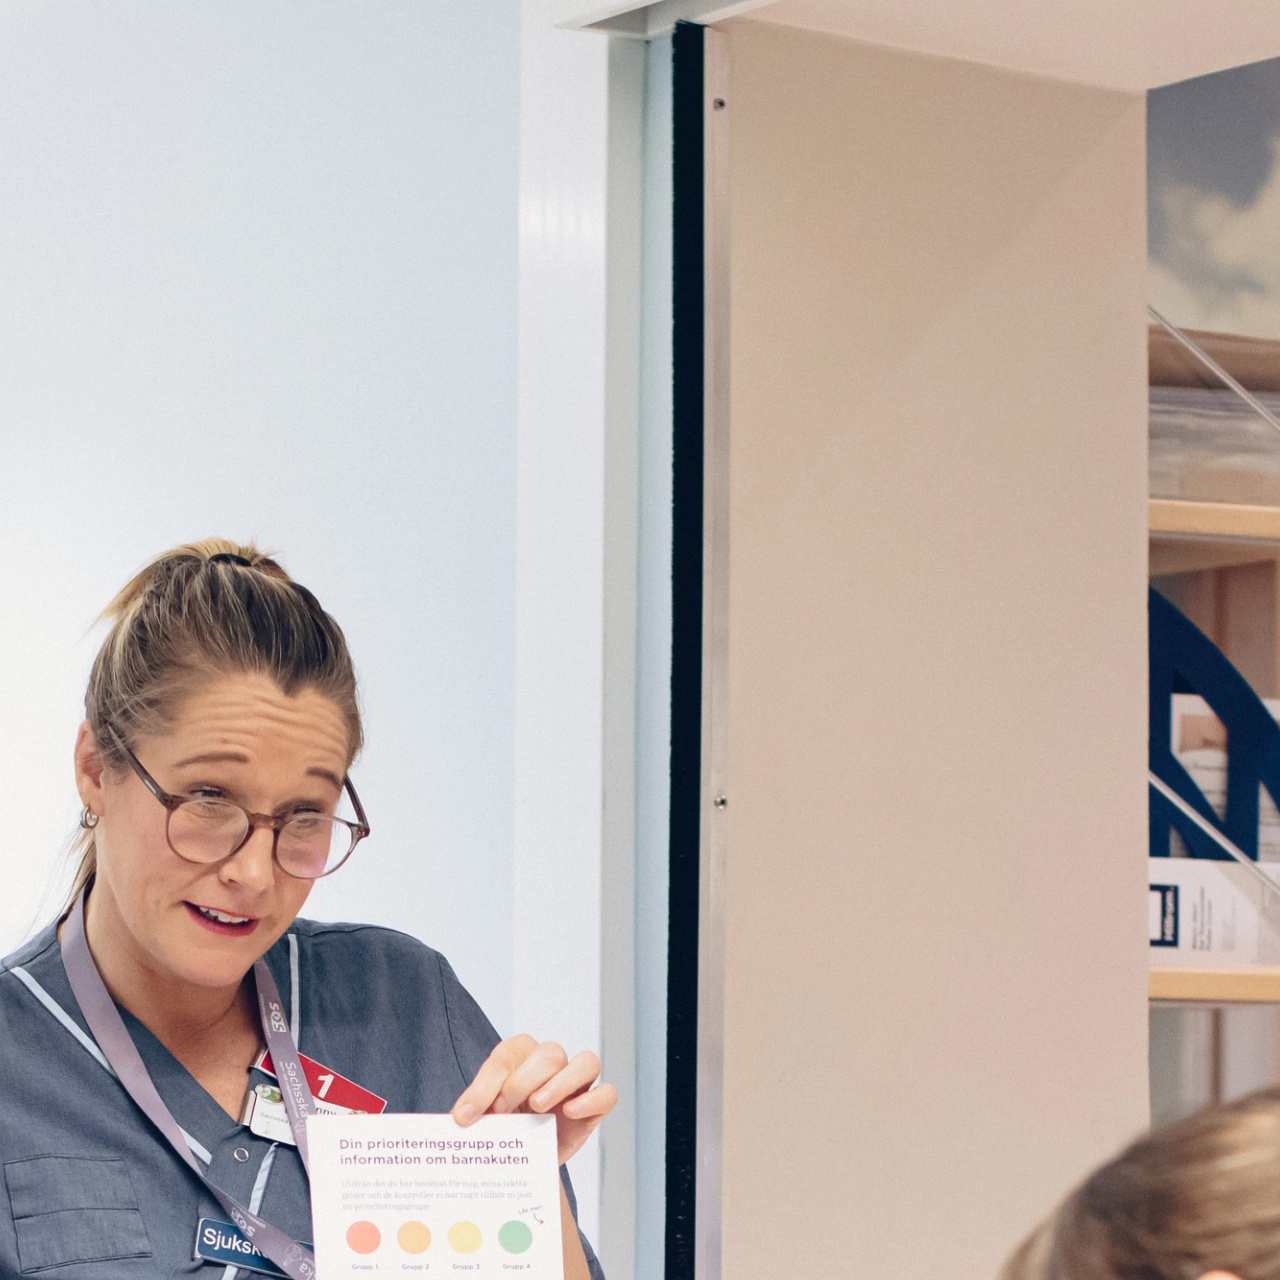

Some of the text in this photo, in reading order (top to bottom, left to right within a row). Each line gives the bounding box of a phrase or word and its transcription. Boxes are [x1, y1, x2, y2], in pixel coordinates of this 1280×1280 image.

[285, 1062, 309, 1119] Sachsska
[317, 1073, 335, 1099] 1
[339, 1139, 523, 1151] Din prioriteringsgrupp och
[340, 1155, 529, 1165] information om barnakuten
